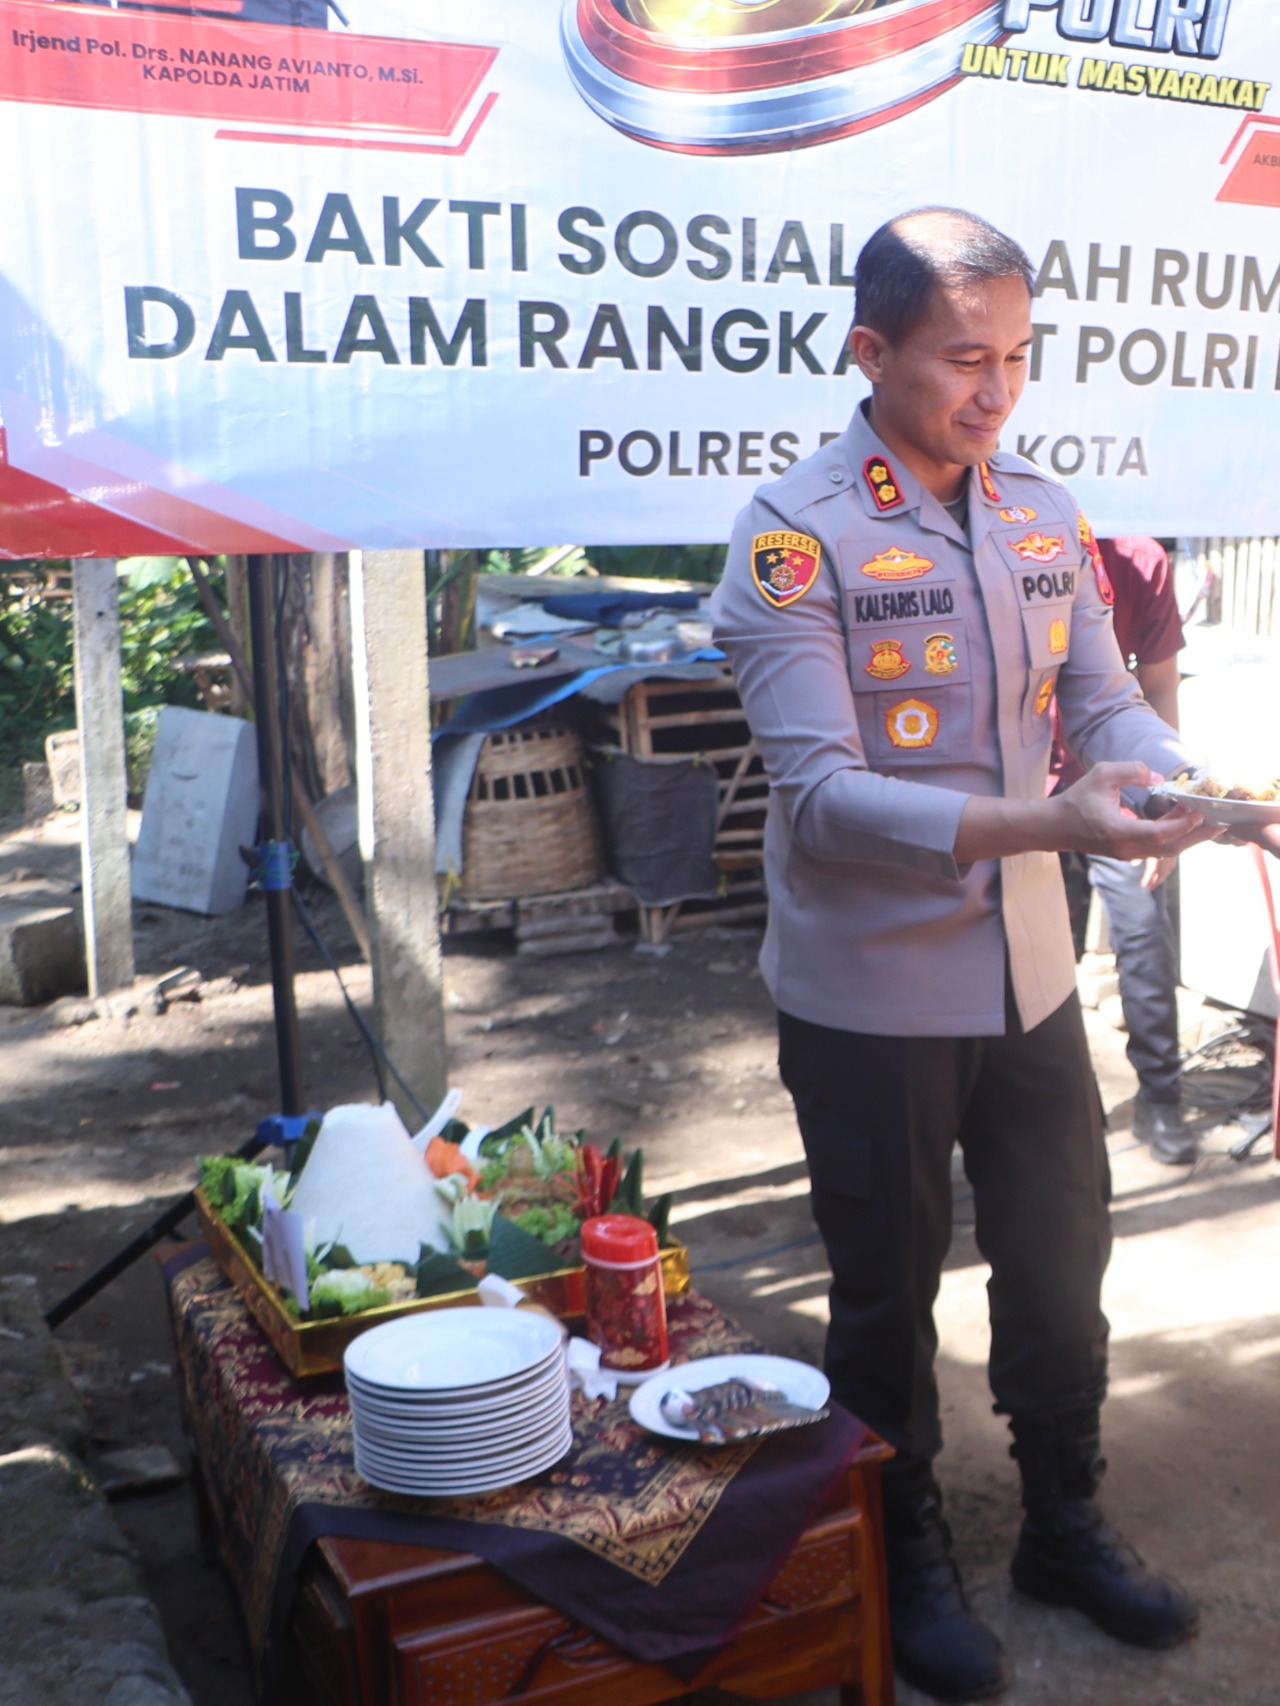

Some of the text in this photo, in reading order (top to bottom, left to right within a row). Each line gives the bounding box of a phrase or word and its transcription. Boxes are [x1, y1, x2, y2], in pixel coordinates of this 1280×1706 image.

[12, 29, 424, 85] Irjend Pol. Drs. NANANG AVIANTO, M.Si.
[143, 64, 310, 94] KAPOLDA JATIM
[960, 43, 1271, 111] UNTUK MASYARAKAT
[236, 188, 528, 271] BAKTI
[558, 207, 857, 287] SOSIAL
[125, 287, 487, 367] DALAM
[1075, 326, 1258, 390] POLRI
[579, 430, 1149, 477] POLRES KOTA
[757, 534, 817, 554] RESERSE
[854, 587, 954, 623] KALFARIS LALO
[1022, 571, 1075, 601] POLRI
